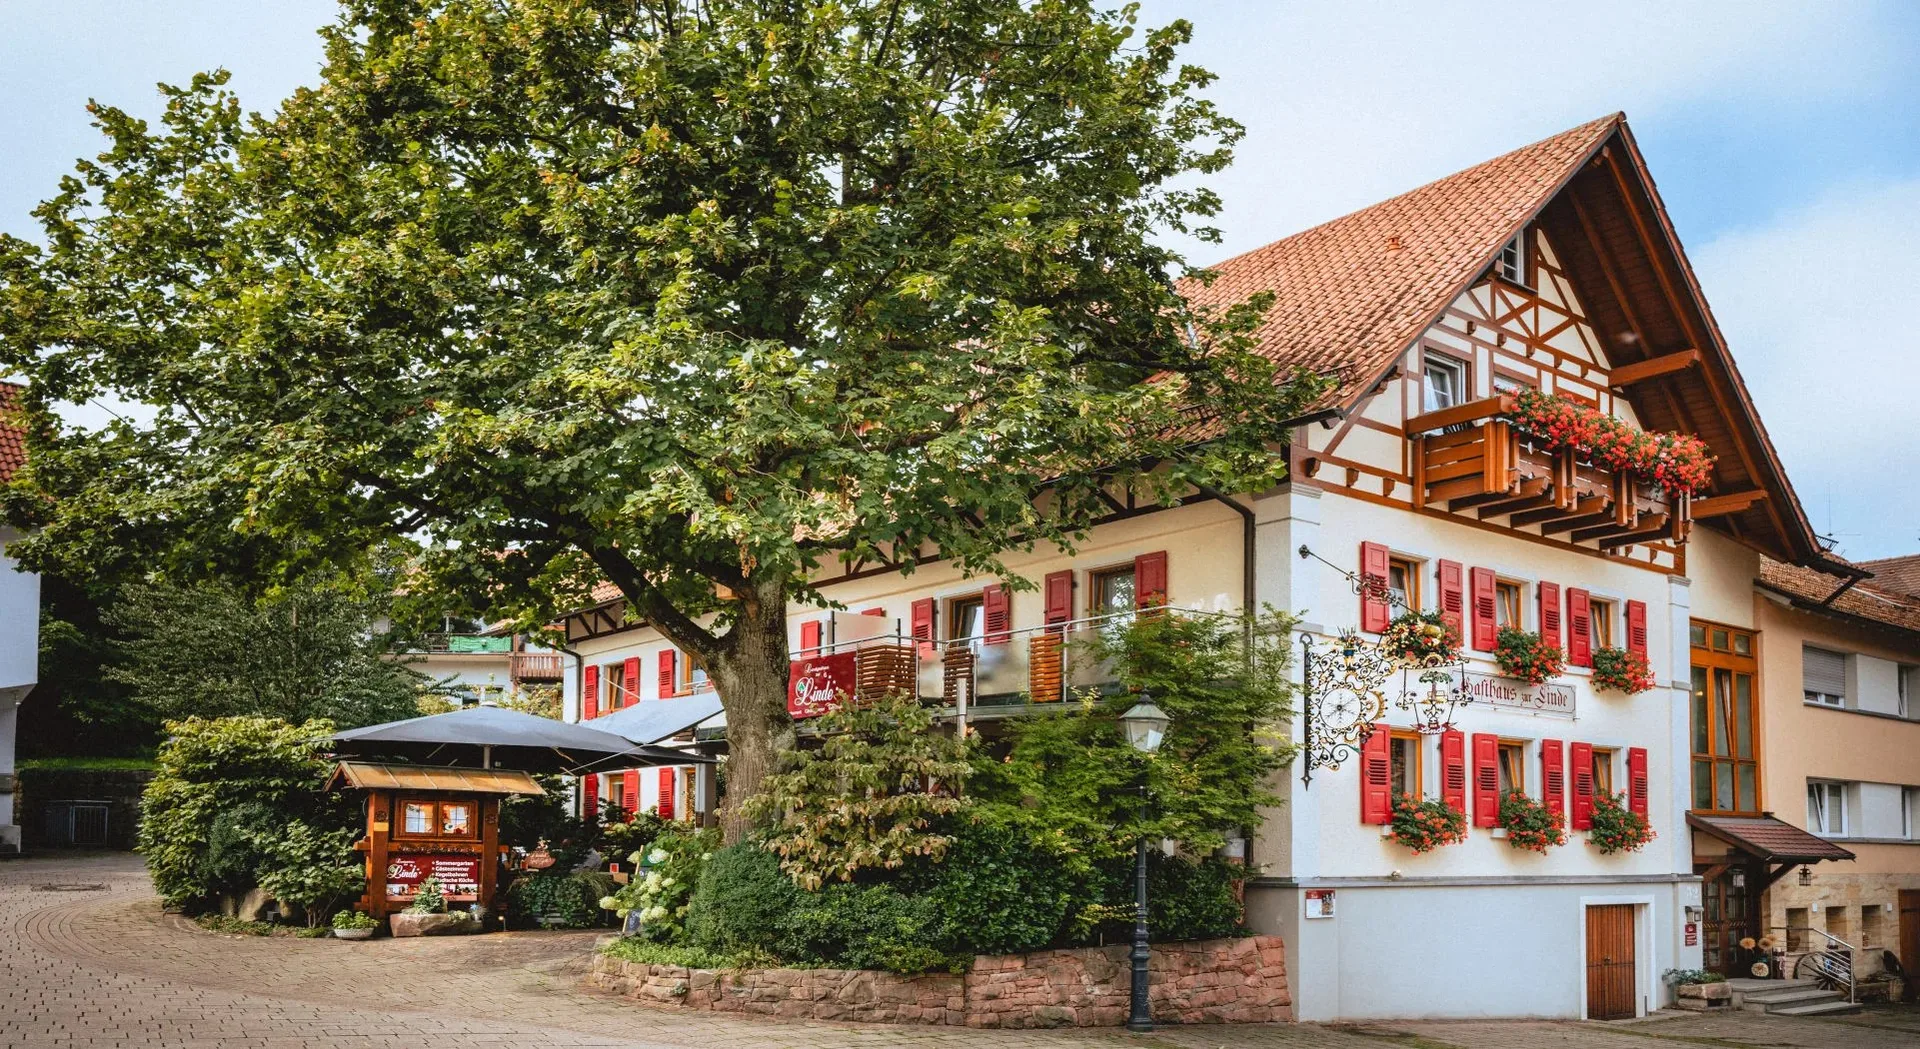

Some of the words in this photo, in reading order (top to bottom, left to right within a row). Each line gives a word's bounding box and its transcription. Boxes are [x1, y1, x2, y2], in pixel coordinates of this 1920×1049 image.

[794, 676, 834, 706] Linde
[1521, 693, 1532, 706] zur
[1534, 684, 1568, 708] Linde
[387, 864, 418, 879] Linde
